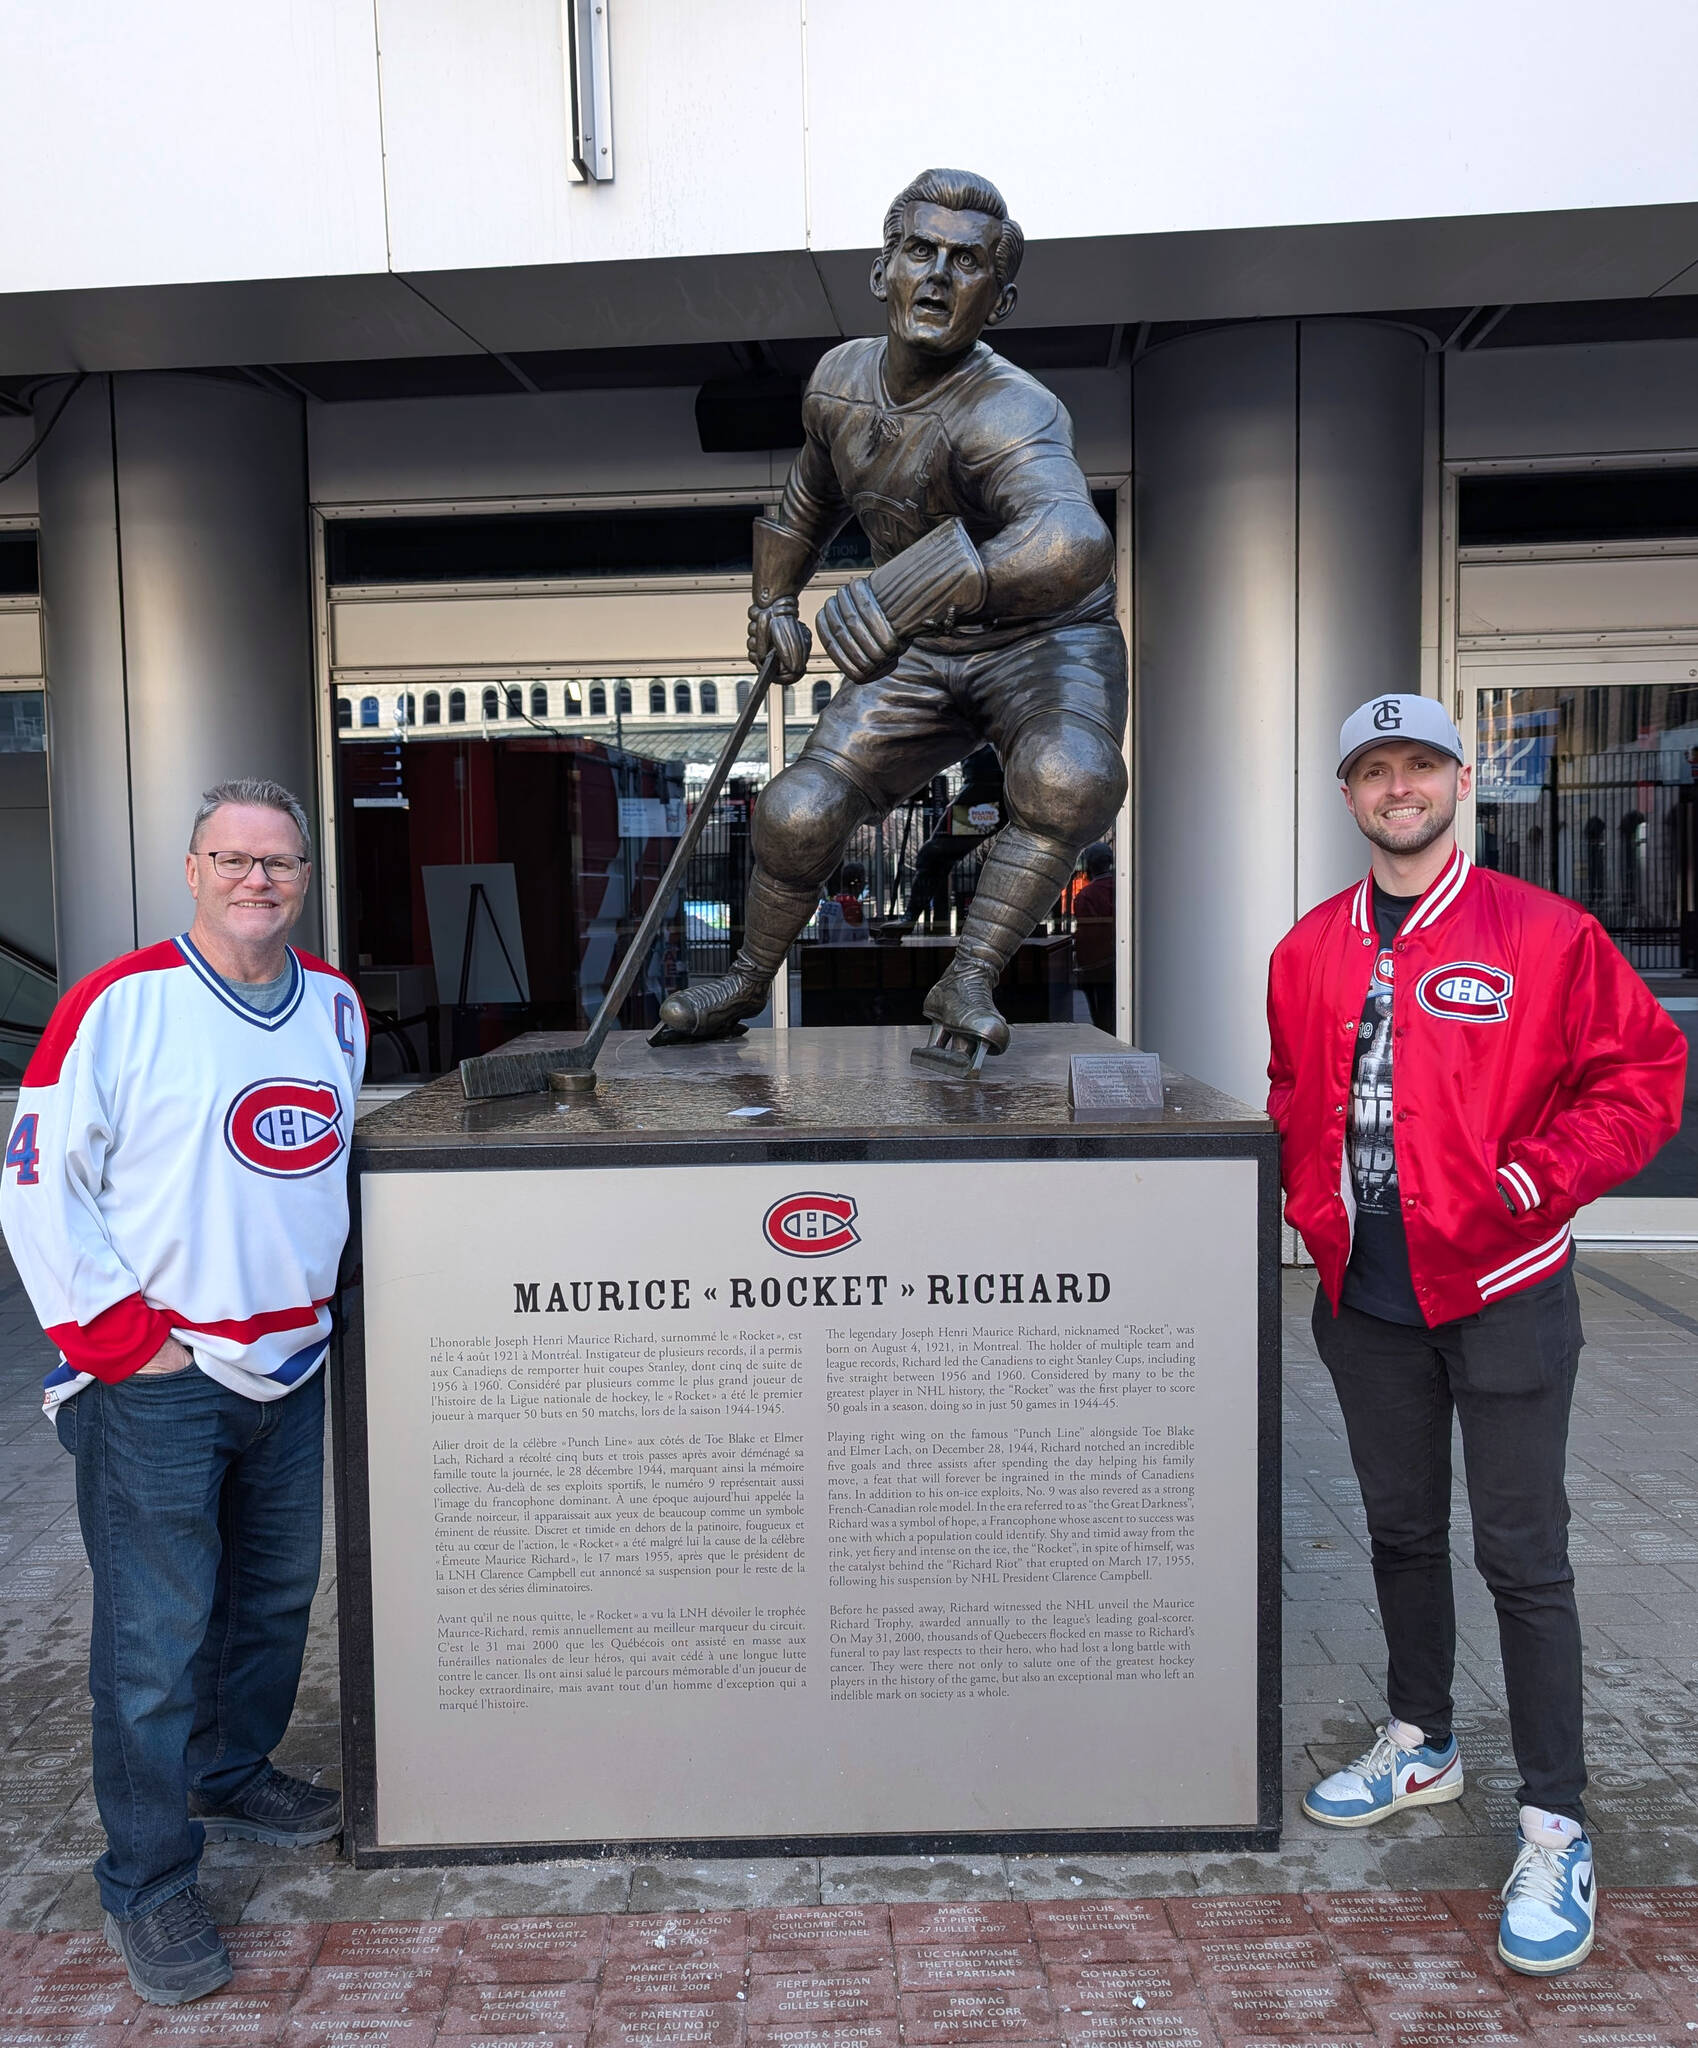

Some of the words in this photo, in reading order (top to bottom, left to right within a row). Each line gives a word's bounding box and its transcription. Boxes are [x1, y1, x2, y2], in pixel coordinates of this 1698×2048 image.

[6, 1113, 40, 1185] 4
[513, 1279, 690, 1313] MAURICE
[729, 1275, 888, 1309] ROCKET
[927, 1272, 1111, 1304] RICHARD
[826, 1327, 846, 1339] The
[850, 1326, 898, 1342] legendary
[900, 1326, 934, 1341] Joseph
[938, 1325, 968, 1337] Henri
[972, 1325, 1014, 1337] Maurice
[1064, 1323, 1120, 1335] nicknamed
[1176, 1325, 1194, 1334] was
[494, 1334, 528, 1350] Joseph
[532, 1333, 562, 1345] Henri
[568, 1332, 612, 1344] Maurice
[720, 1329, 728, 1341] le
[788, 1329, 802, 1339] est
[826, 1371, 848, 1383] five
[848, 1370, 892, 1386] straight
[892, 1370, 934, 1382] between
[942, 1369, 970, 1381] 1956
[972, 1369, 990, 1381] and
[1030, 1367, 1094, 1380] Considered
[1094, 1367, 1112, 1382] by
[1112, 1370, 1146, 1382] many
[1146, 1368, 1160, 1378] to
[1160, 1366, 1174, 1378] be
[1176, 1366, 1194, 1378] the
[828, 1429, 866, 1445] Playing
[870, 1429, 896, 1445] right
[900, 1430, 928, 1444] wing
[930, 1432, 944, 1440] on
[950, 1428, 966, 1440] the
[972, 1427, 1008, 1439] famous
[1090, 1425, 1138, 1441] alongside
[1142, 1425, 1162, 1437] Toe
[1168, 1424, 1194, 1436] Blake
[436, 1568, 444, 1580] la
[448, 1567, 476, 1579] LNH
[480, 1566, 524, 1579] Clarence
[528, 1565, 576, 1581] Campbell
[580, 1566, 594, 1577] eut
[646, 1566, 656, 1575] sa
[656, 1564, 714, 1578] suspension
[716, 1565, 740, 1577] pour
[744, 1561, 752, 1573] le
[756, 1562, 778, 1573] reste
[782, 1560, 794, 1572] de
[798, 1560, 806, 1572] la
[830, 1616, 870, 1629] Richard
[920, 1614, 960, 1627] awarded
[966, 1613, 1010, 1629] annually
[1016, 1615, 1026, 1625] to
[1032, 1613, 1048, 1625] the
[1096, 1611, 1132, 1627] leading
[530, 1625, 562, 1636] remis
[564, 1622, 634, 1635] annuellement
[636, 1625, 648, 1633] au
[654, 1620, 696, 1633] meilleur
[700, 1623, 750, 1635] marqueur
[752, 1619, 766, 1631] du
[523, 1931, 588, 1939] SCHWARTZ
[669, 1962, 720, 1971] LACROIX
[625, 1974, 677, 1982] PREMIER
[645, 1984, 678, 1992] AVRIL
[1549, 1981, 1572, 1990] LEE
[1231, 1990, 1272, 1998] SIMON
[950, 1997, 1005, 2005] PROMAG
[1299, 1999, 1338, 2008] JONES
[933, 2008, 984, 2017] DISPLAY
[1557, 2004, 1577, 2013] GO
[1579, 2004, 1614, 2012] HABS
[641, 2010, 714, 2019] PARENTEAU
[1389, 2011, 1446, 2021] CHURMA
[1456, 2010, 1503, 2019] DAIGLE
[311, 2021, 349, 2029] KEVIN
[352, 2020, 413, 2029] BUDNING
[934, 2021, 959, 2029] FAN
[962, 2020, 999, 2028] SINCE
[1002, 2019, 1027, 2027] 1977
[1120, 2016, 1183, 2026] PARTISAN
[620, 2022, 660, 2031] MERCI
[663, 2022, 680, 2030] AU
[1402, 2023, 1425, 2032] LES
[1428, 2022, 1503, 2032] CANADIENS
[326, 2032, 360, 2041] HABS
[363, 2031, 389, 2040] FAN
[767, 2031, 818, 2040] SHOOTS
[835, 2027, 882, 2037] SCORES
[1130, 2028, 1199, 2037] TOUJOURS
[625, 2035, 653, 2043] GUY
[656, 2033, 712, 2042] LAFLEUR
[1400, 2035, 1454, 2045] SHOOTS
